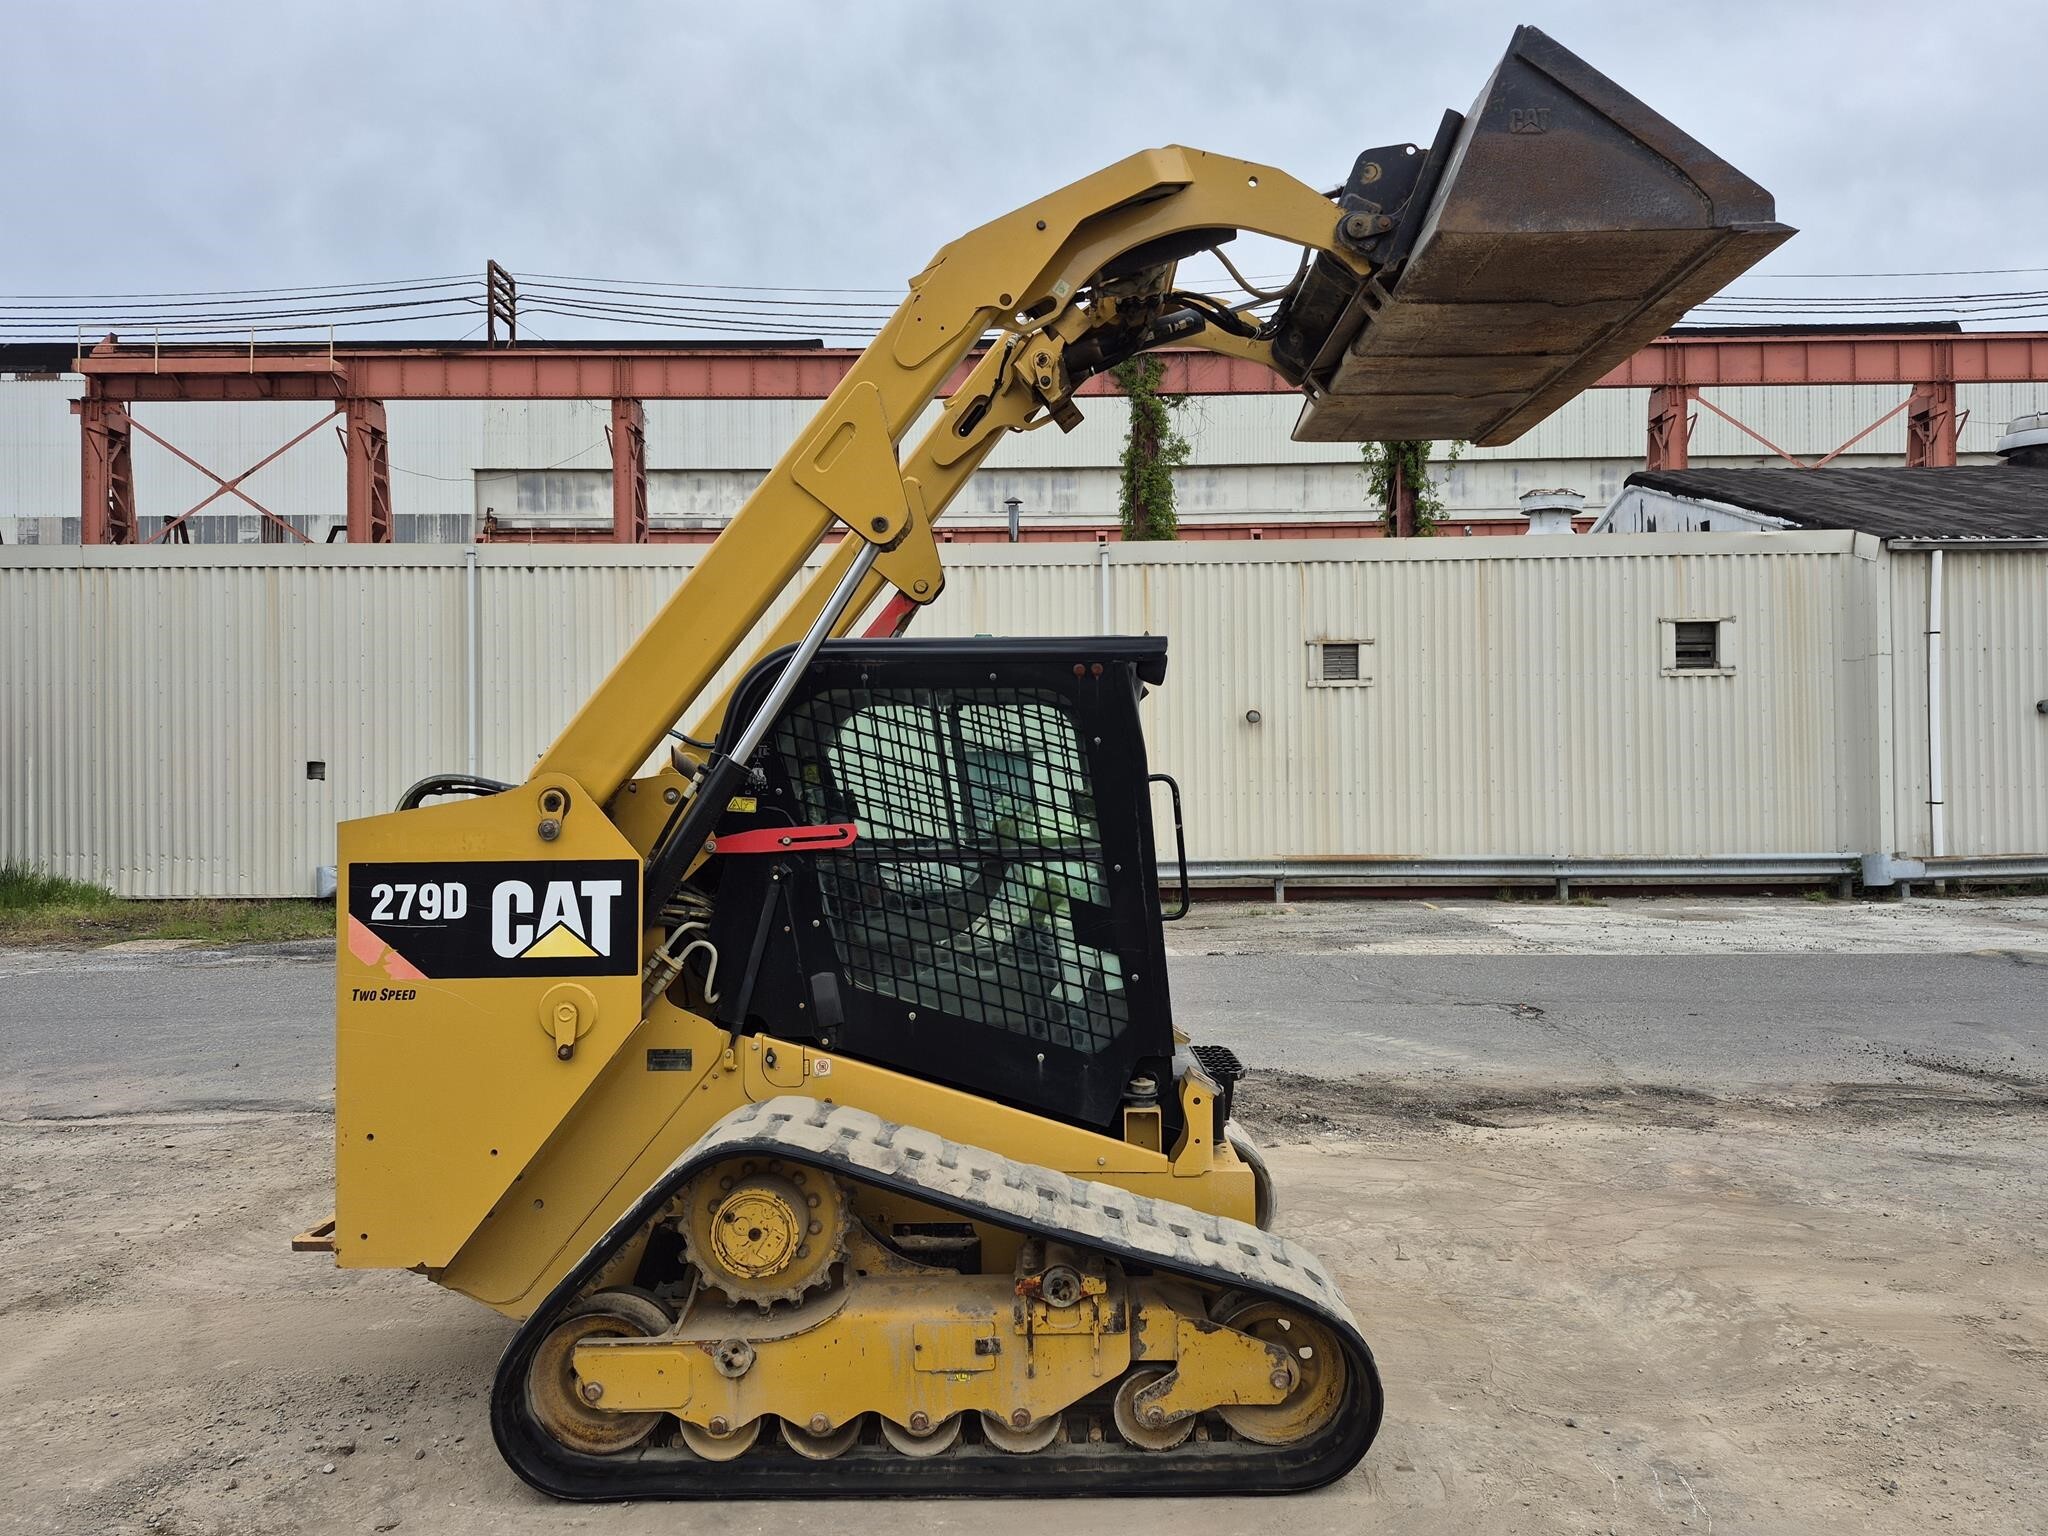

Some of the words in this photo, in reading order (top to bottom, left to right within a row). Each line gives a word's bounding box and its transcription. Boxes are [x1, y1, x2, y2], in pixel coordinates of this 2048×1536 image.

[1510, 107, 1552, 134] CAT
[370, 883, 467, 920] 279D
[491, 880, 622, 958] CAT
